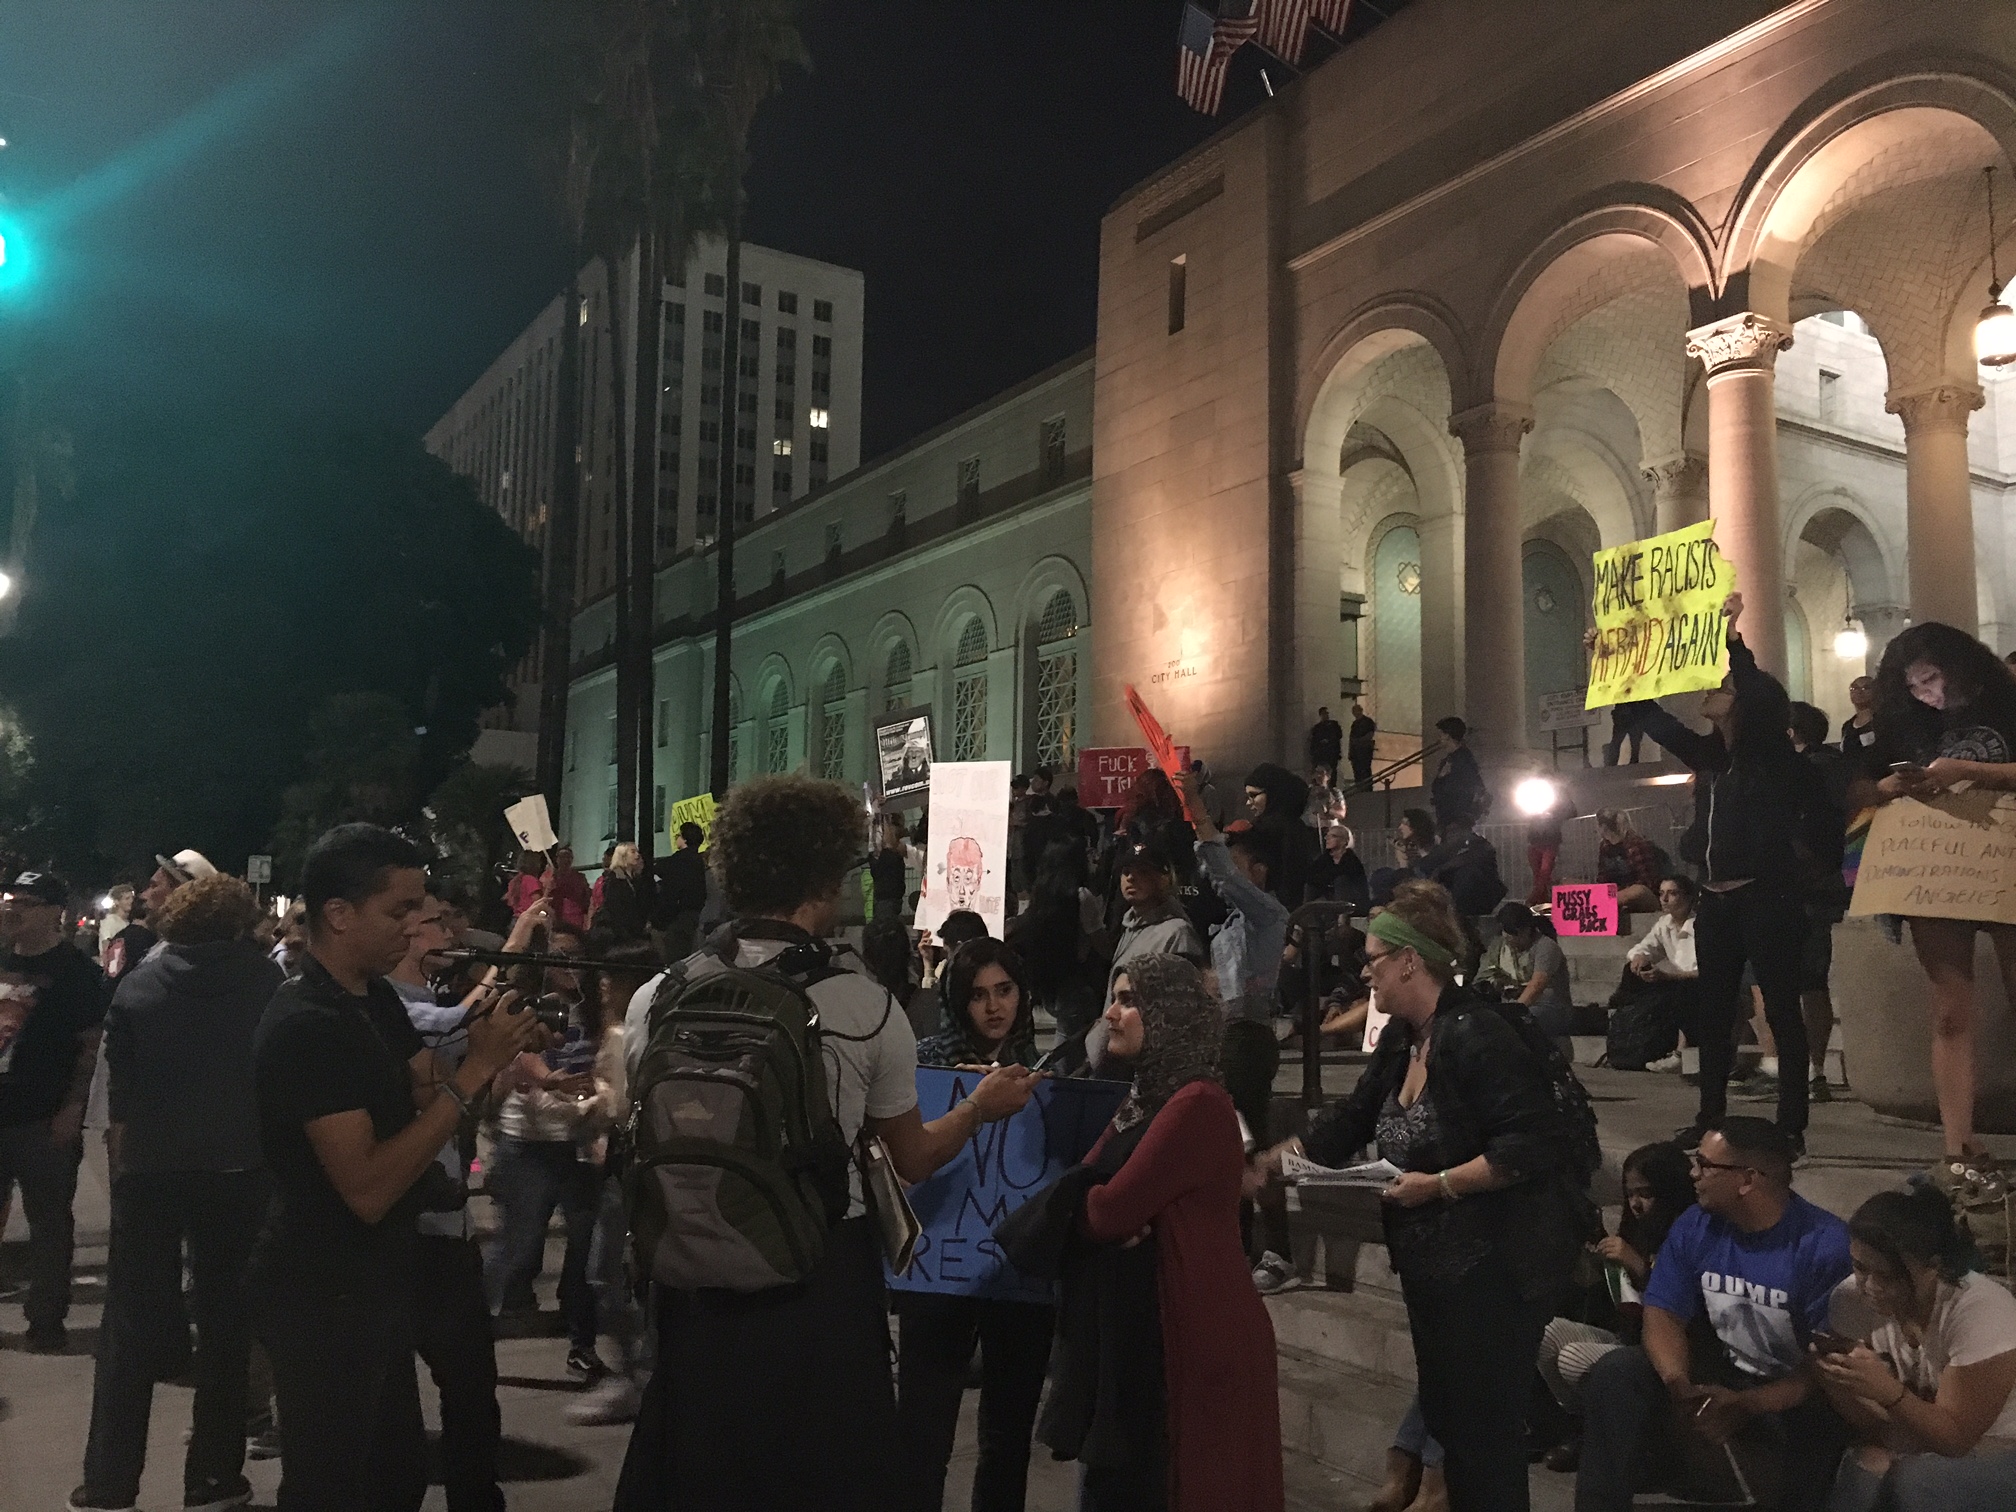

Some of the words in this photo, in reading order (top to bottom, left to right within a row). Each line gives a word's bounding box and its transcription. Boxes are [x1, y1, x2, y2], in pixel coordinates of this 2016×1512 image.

[1594, 552, 1644, 616] MAKE
[1650, 538, 1719, 600] RACISTS
[1591, 617, 1664, 685] AFRAID
[1658, 608, 1724, 675] AGAIN
[1151, 672, 1170, 684] CITY
[1174, 666, 1198, 679] HALL
[1098, 755, 1137, 773] FUCK
[1557, 889, 1591, 909] PUSSY
[1579, 917, 1608, 933] BACK
